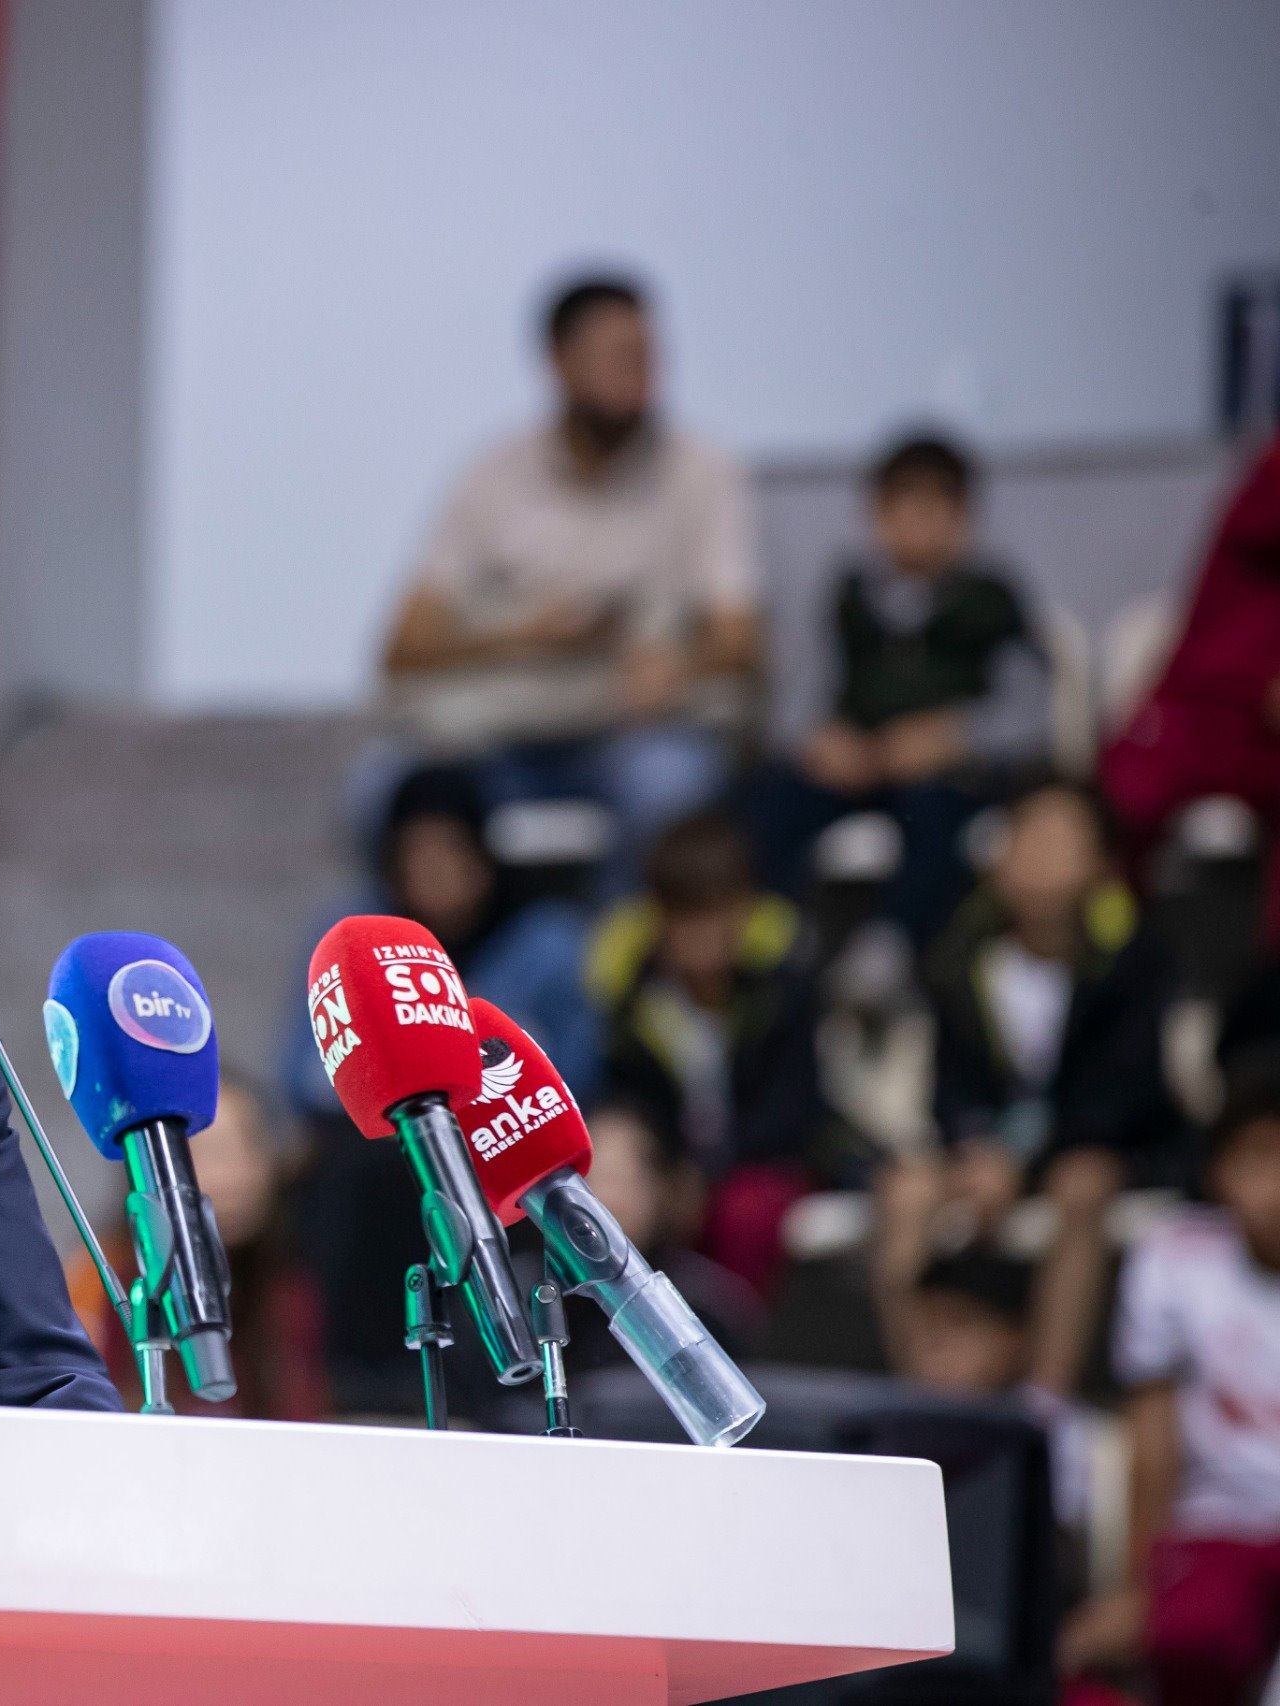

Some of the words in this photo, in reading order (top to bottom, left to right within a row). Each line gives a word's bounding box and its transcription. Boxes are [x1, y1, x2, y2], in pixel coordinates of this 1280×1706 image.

[132, 990, 175, 1018] bir
[384, 964, 468, 1011] SON
[470, 1085, 562, 1152] anka
[481, 1130, 524, 1162] HABER
[523, 1102, 569, 1134] AJANSI
